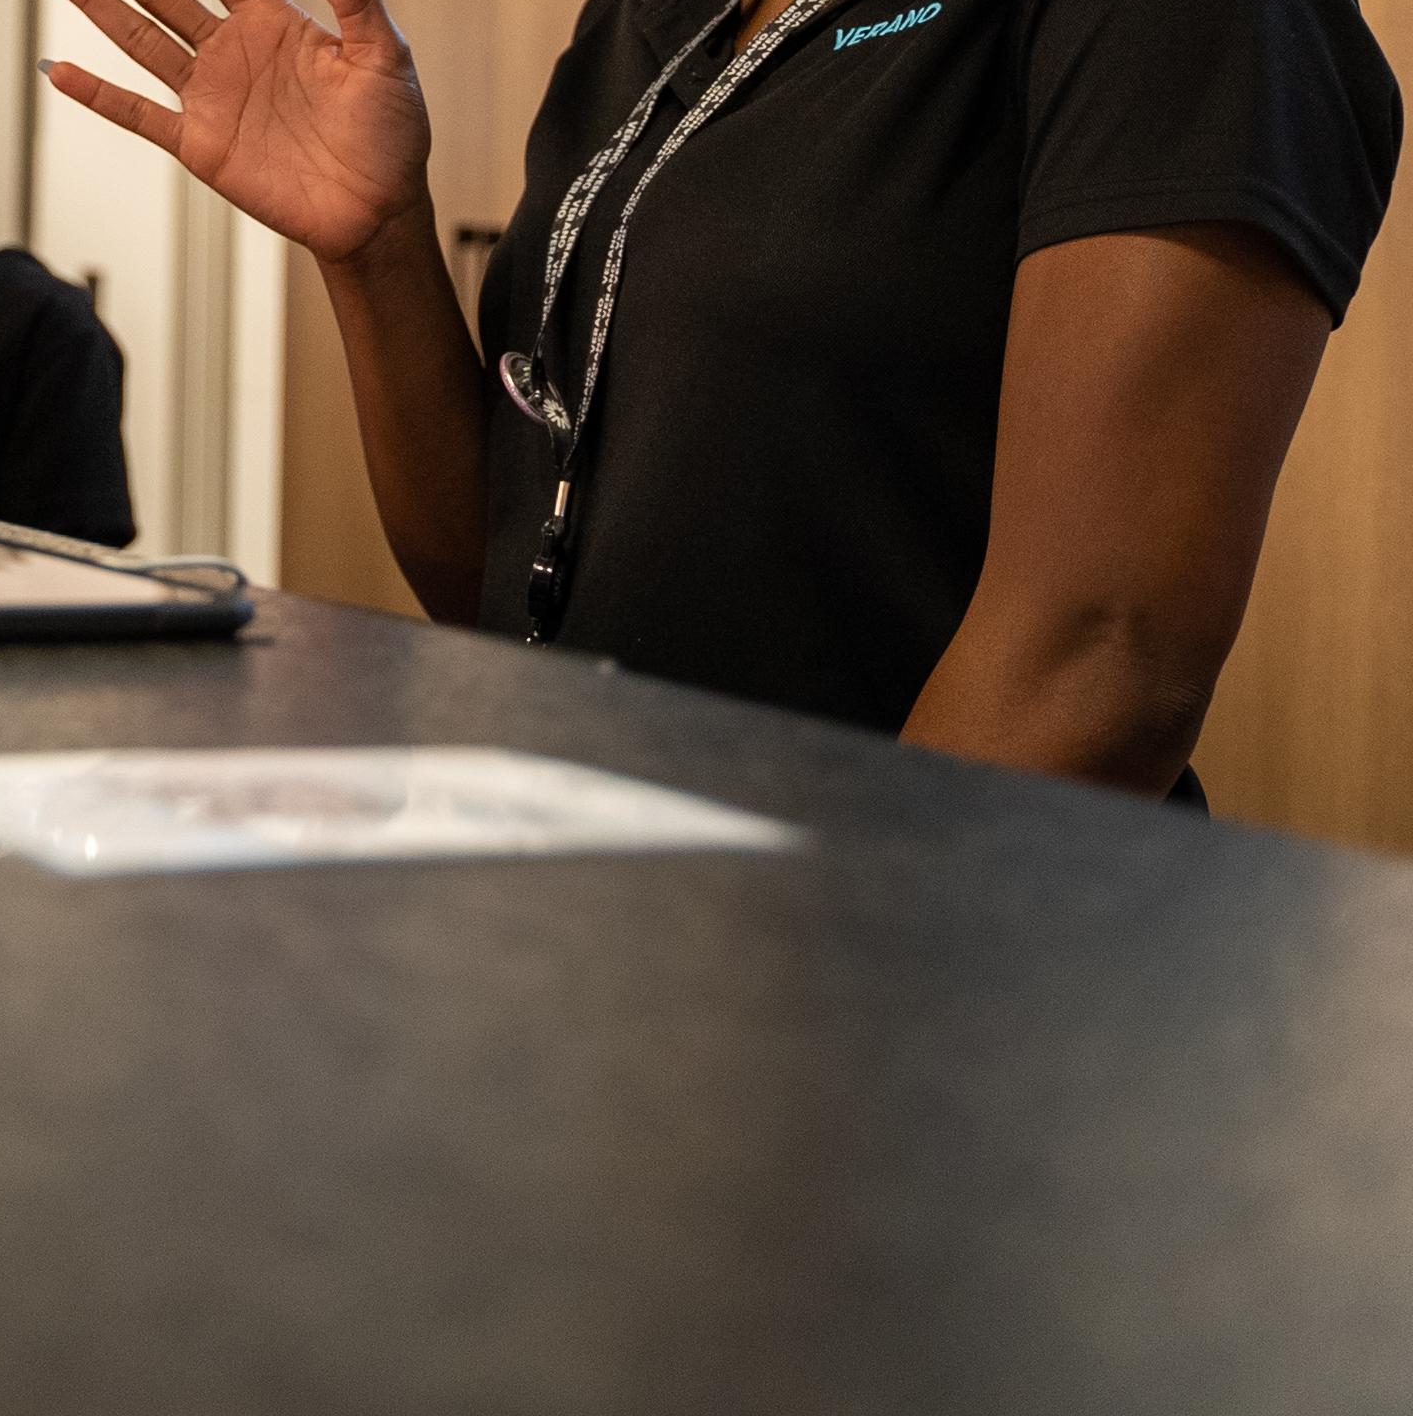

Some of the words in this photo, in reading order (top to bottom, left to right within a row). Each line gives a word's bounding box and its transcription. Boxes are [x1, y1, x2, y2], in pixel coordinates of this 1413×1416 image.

[758, 9, 802, 51] VERANO
[833, 2, 942, 50] VERANO
[727, 33, 769, 76] VERANO
[711, 60, 752, 103] VERANO
[609, 120, 639, 164] VERANO
[582, 148, 613, 190] VERANO
[557, 173, 587, 219] VERANO
[578, 172, 608, 217] VERANO
[558, 199, 582, 249] VERANO
[544, 230, 560, 284] VERANO
[557, 227, 579, 278] VERANO
